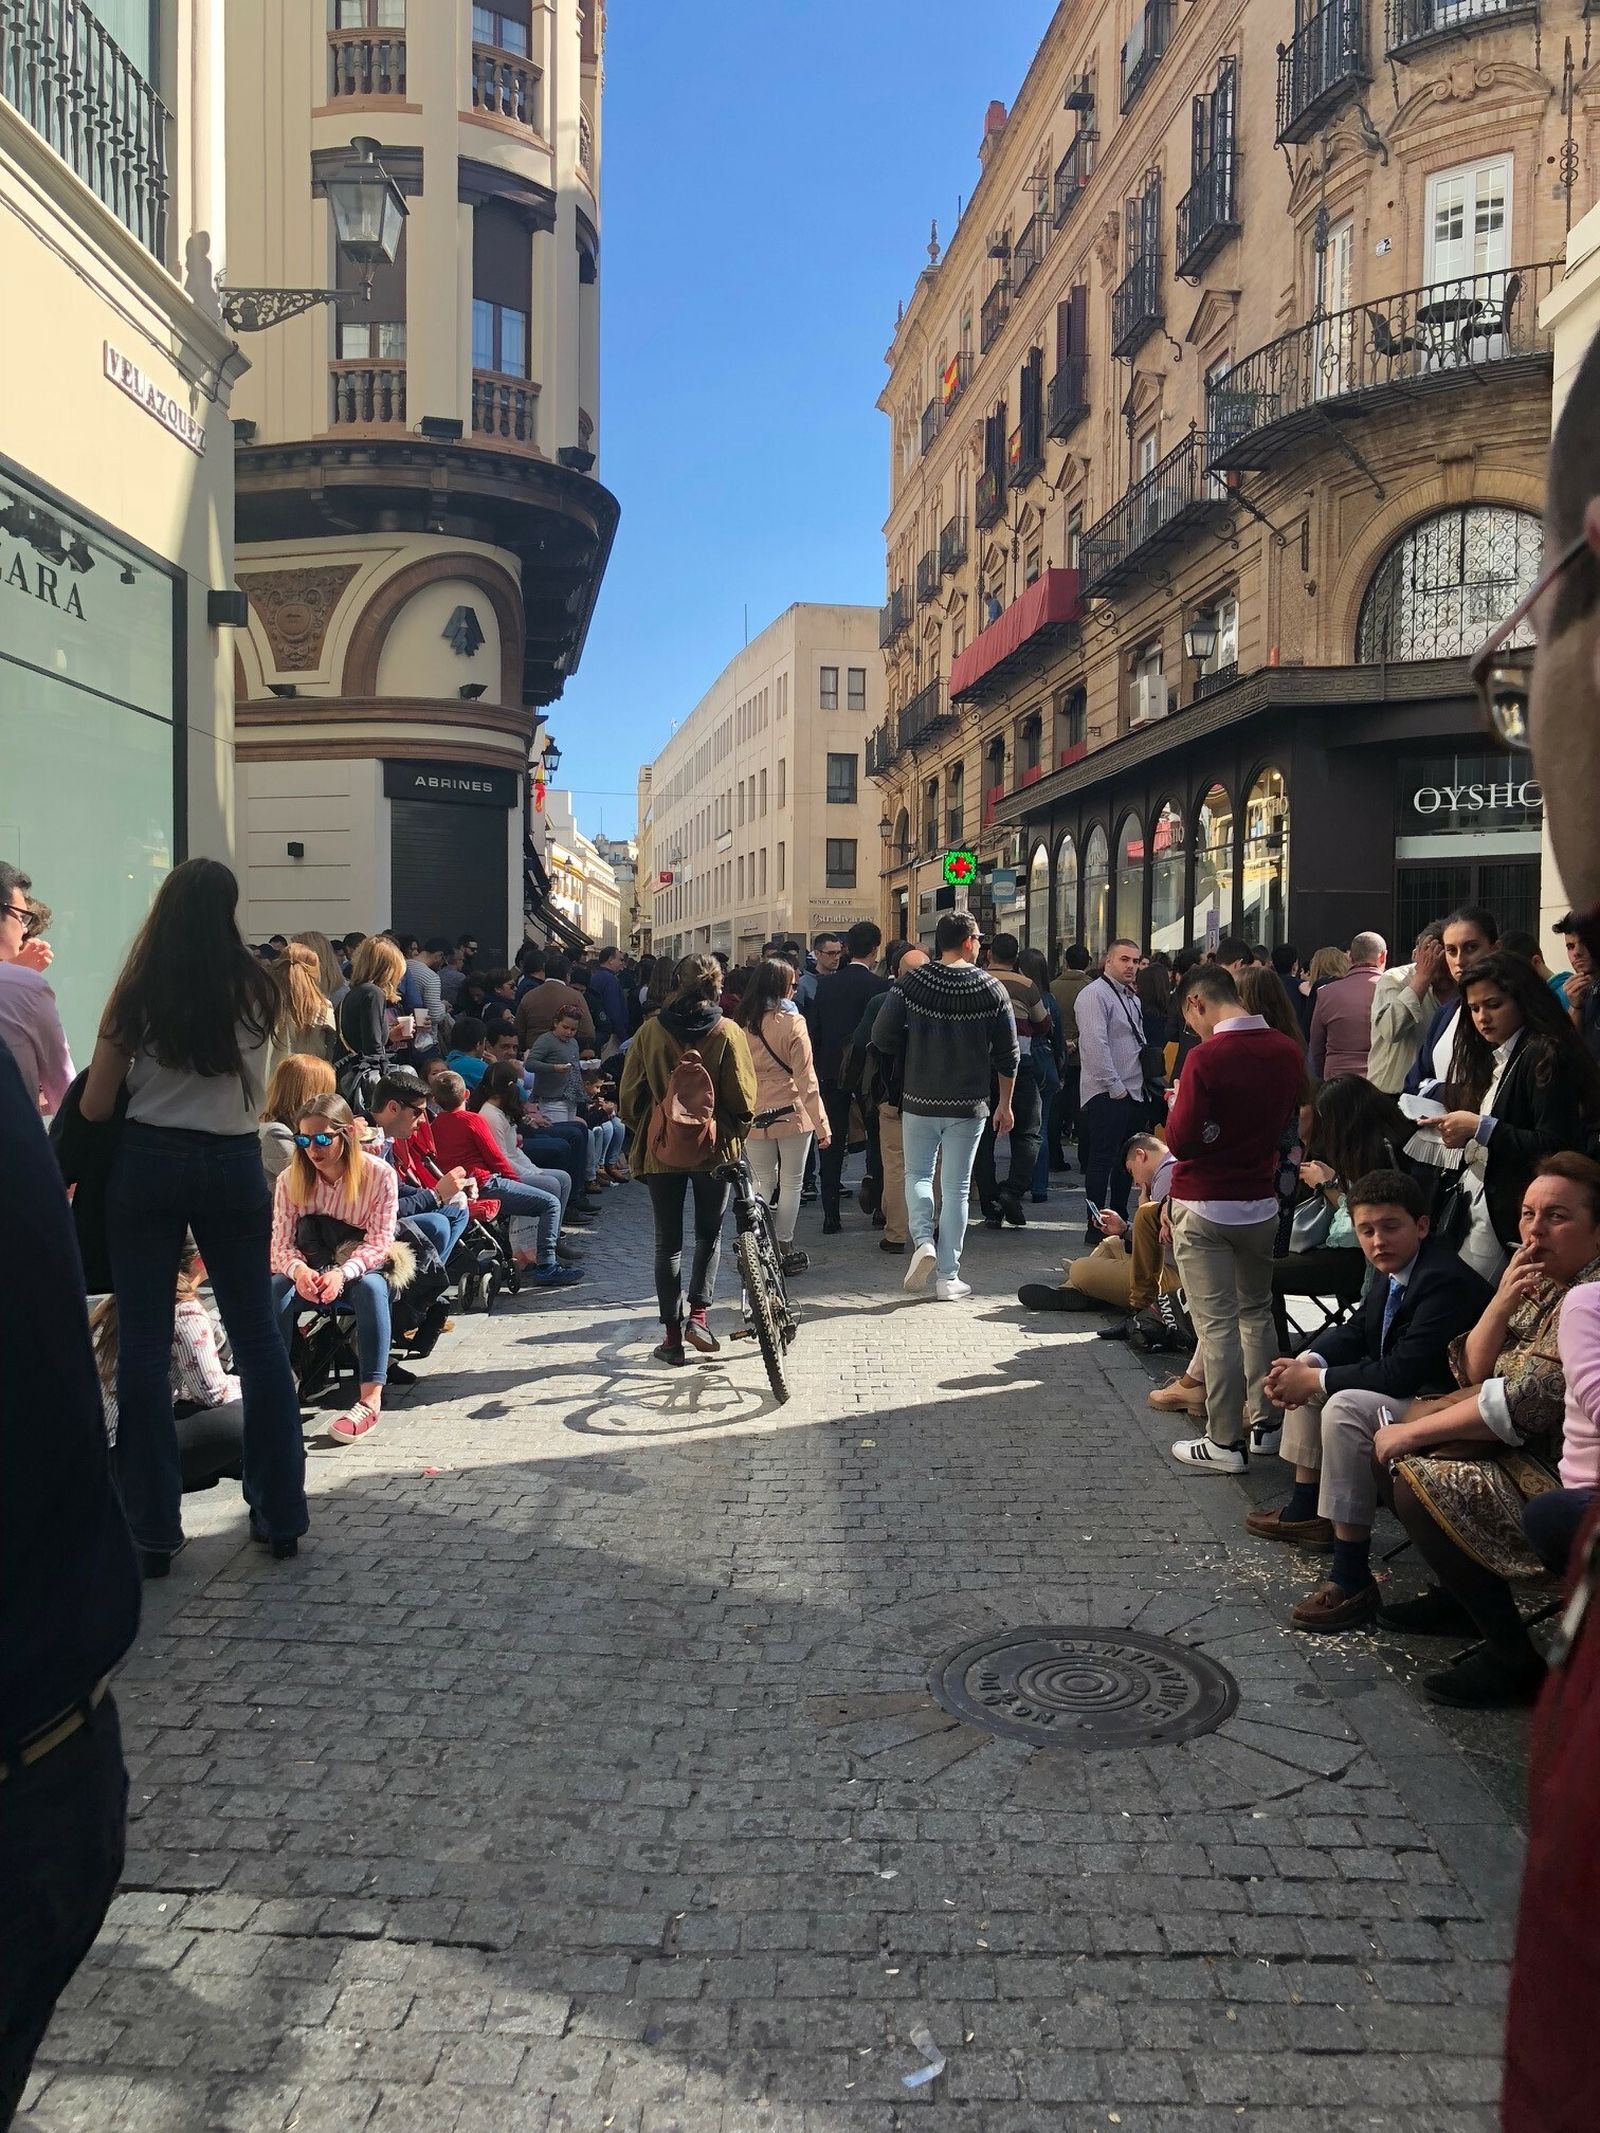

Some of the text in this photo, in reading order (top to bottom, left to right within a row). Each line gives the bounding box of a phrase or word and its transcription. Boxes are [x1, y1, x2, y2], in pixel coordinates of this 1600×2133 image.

[109, 347, 207, 453] VELAZQUEZ
[0, 551, 88, 621] ARA
[414, 776, 493, 793] ABRINES
[1413, 779, 1544, 814] OYSHO
